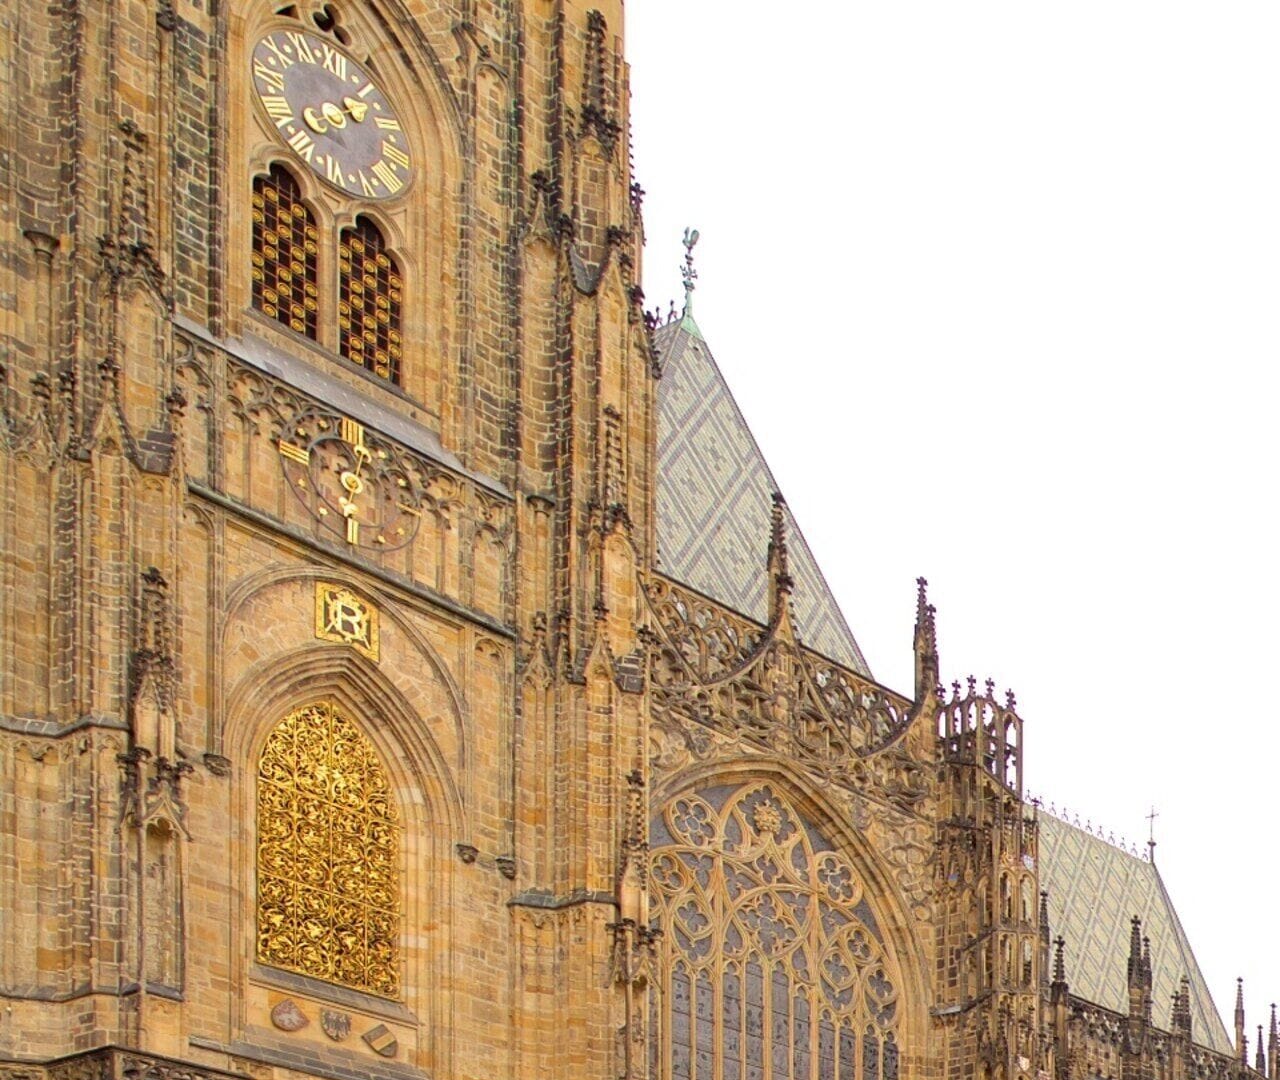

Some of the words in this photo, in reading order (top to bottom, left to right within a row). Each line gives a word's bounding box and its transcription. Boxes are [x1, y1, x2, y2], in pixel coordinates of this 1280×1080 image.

[262, 35, 294, 69] X
[321, 42, 346, 81] XII
[373, 117, 401, 131] II
[326, 154, 346, 188] VI
[382, 140, 409, 170] III
[358, 169, 377, 197] V
